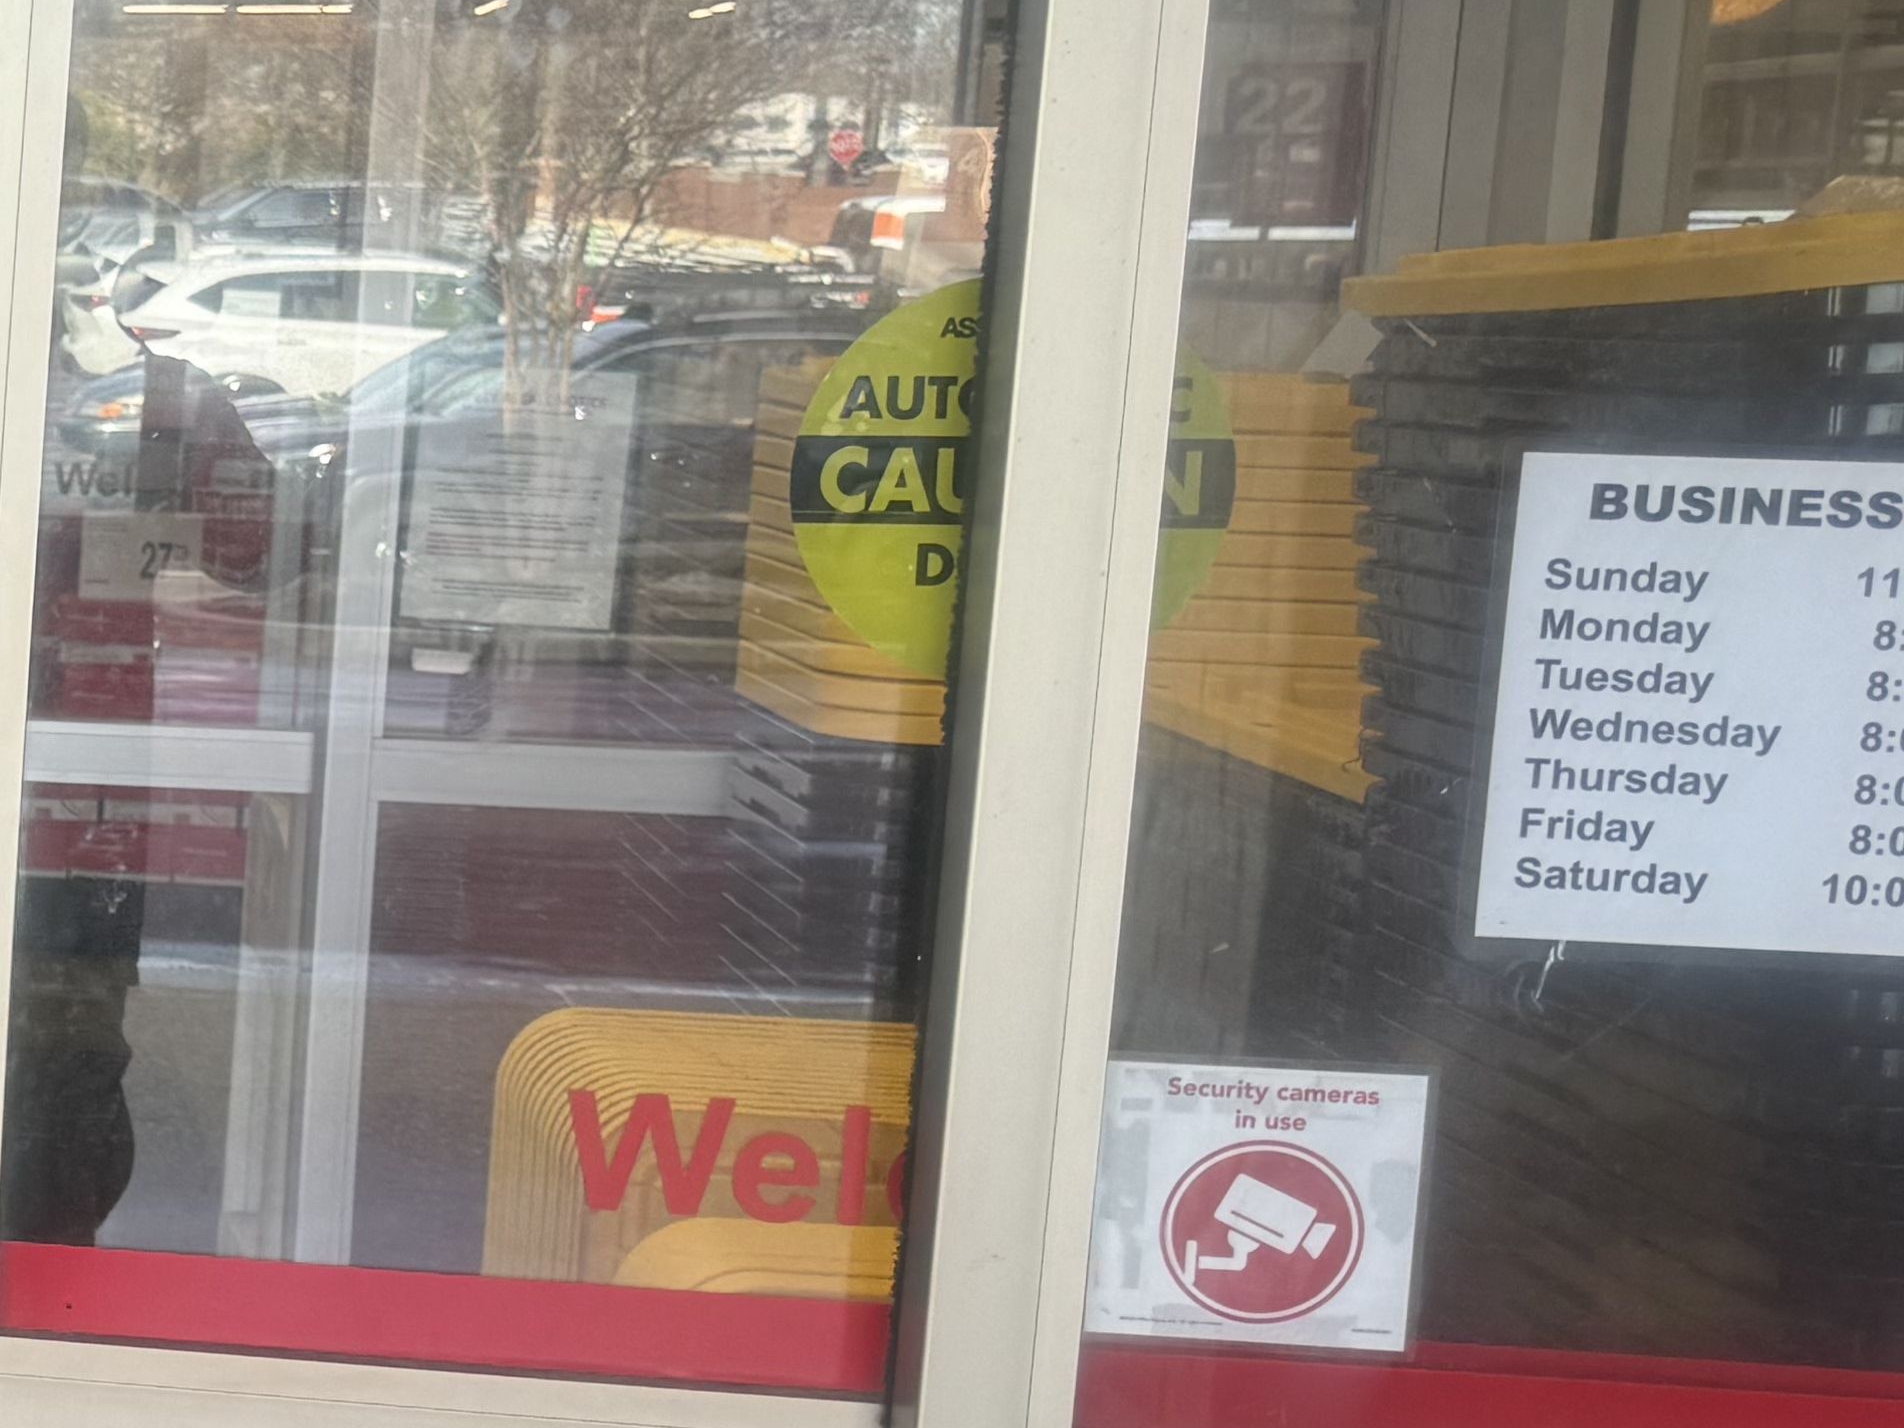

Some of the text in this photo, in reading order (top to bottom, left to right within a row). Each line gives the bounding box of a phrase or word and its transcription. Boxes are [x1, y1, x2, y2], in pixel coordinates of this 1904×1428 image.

[1589, 482, 1904, 530] BUSINESS
[1544, 557, 1710, 602] Sunday
[1539, 608, 1711, 652] Monday
[1534, 658, 1715, 704] Tuesday
[1528, 707, 1782, 756] Wednesday
[1523, 758, 1729, 805] Thursday
[1518, 807, 1655, 852] Friday
[1513, 856, 1709, 904] Saturday
[1167, 1076, 1380, 1106] Security cameras
[1234, 1109, 1307, 1131] in use
[567, 1088, 906, 1228] Wel
